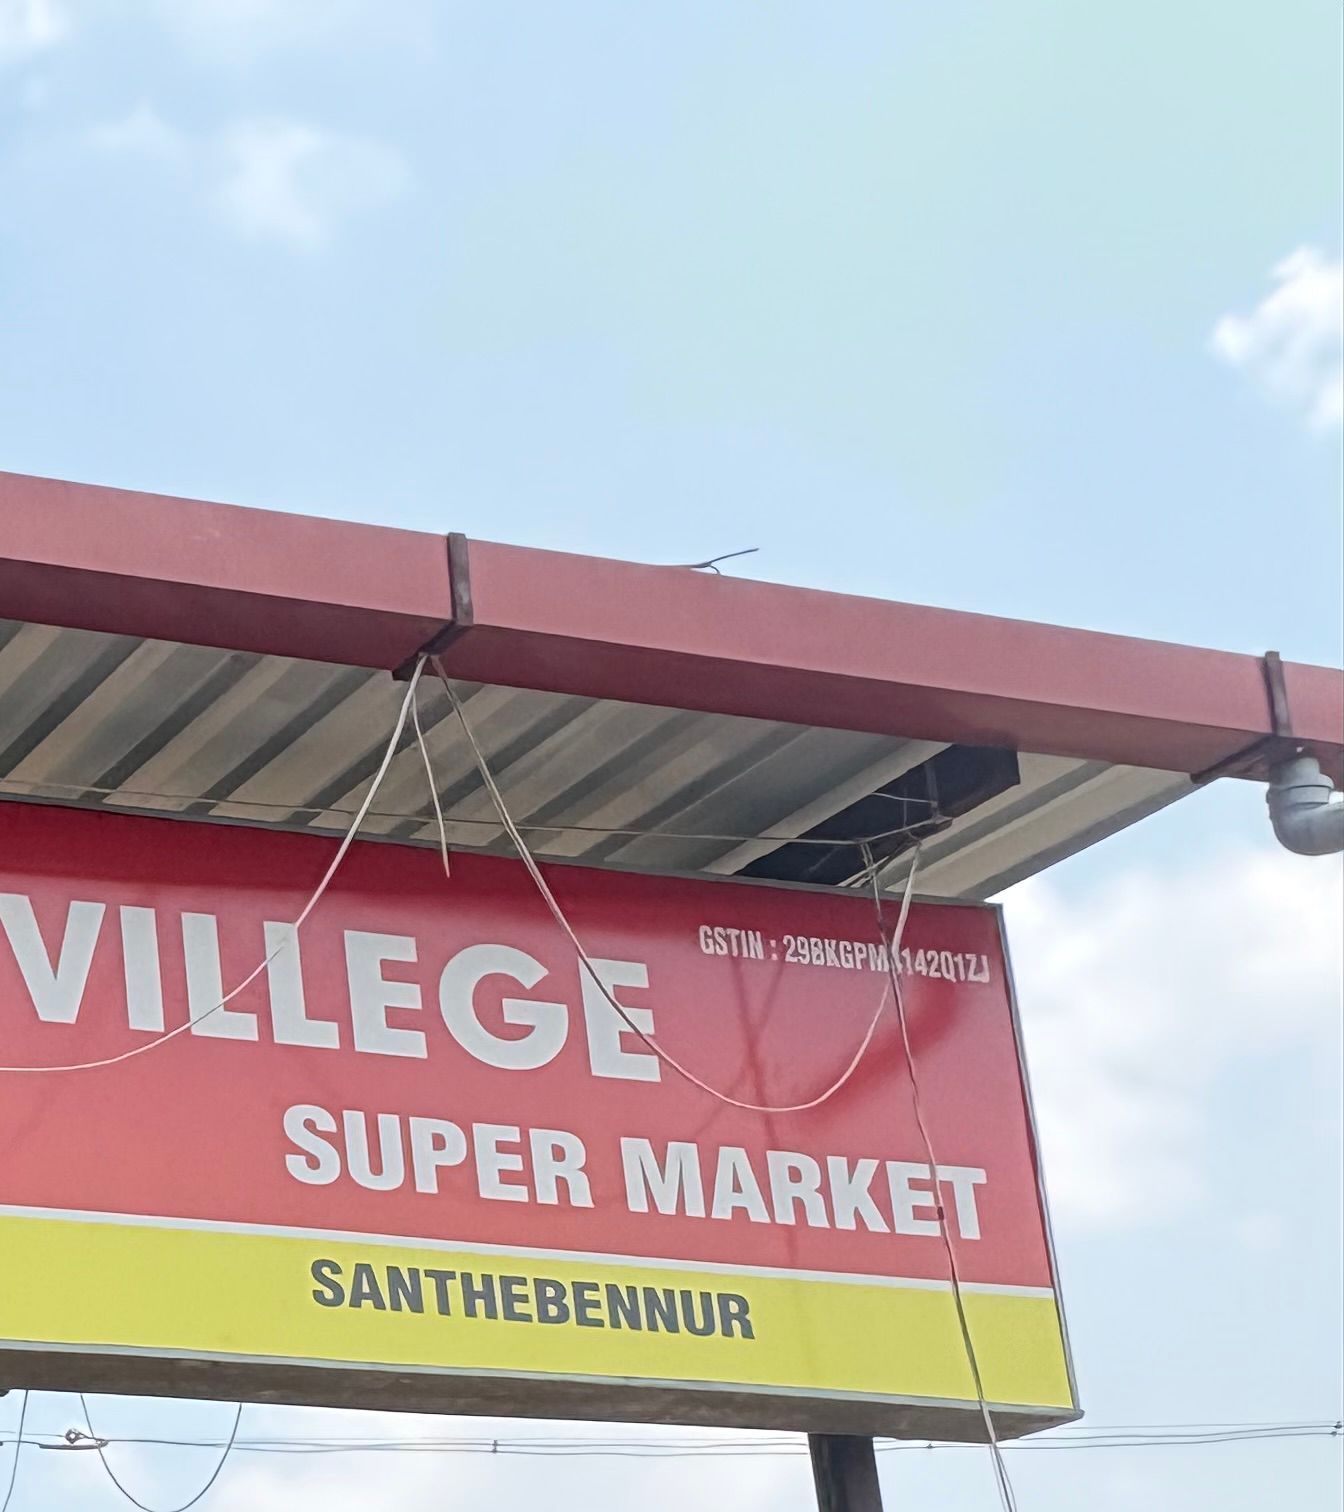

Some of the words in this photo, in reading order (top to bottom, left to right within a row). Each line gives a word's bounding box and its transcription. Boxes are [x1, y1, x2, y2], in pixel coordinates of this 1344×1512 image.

[698, 924, 764, 960] GSTIN
[283, 1103, 595, 1210] SUPER
[620, 1137, 988, 1242] MARKET
[311, 1258, 756, 1342] SANTHEBENNUR
